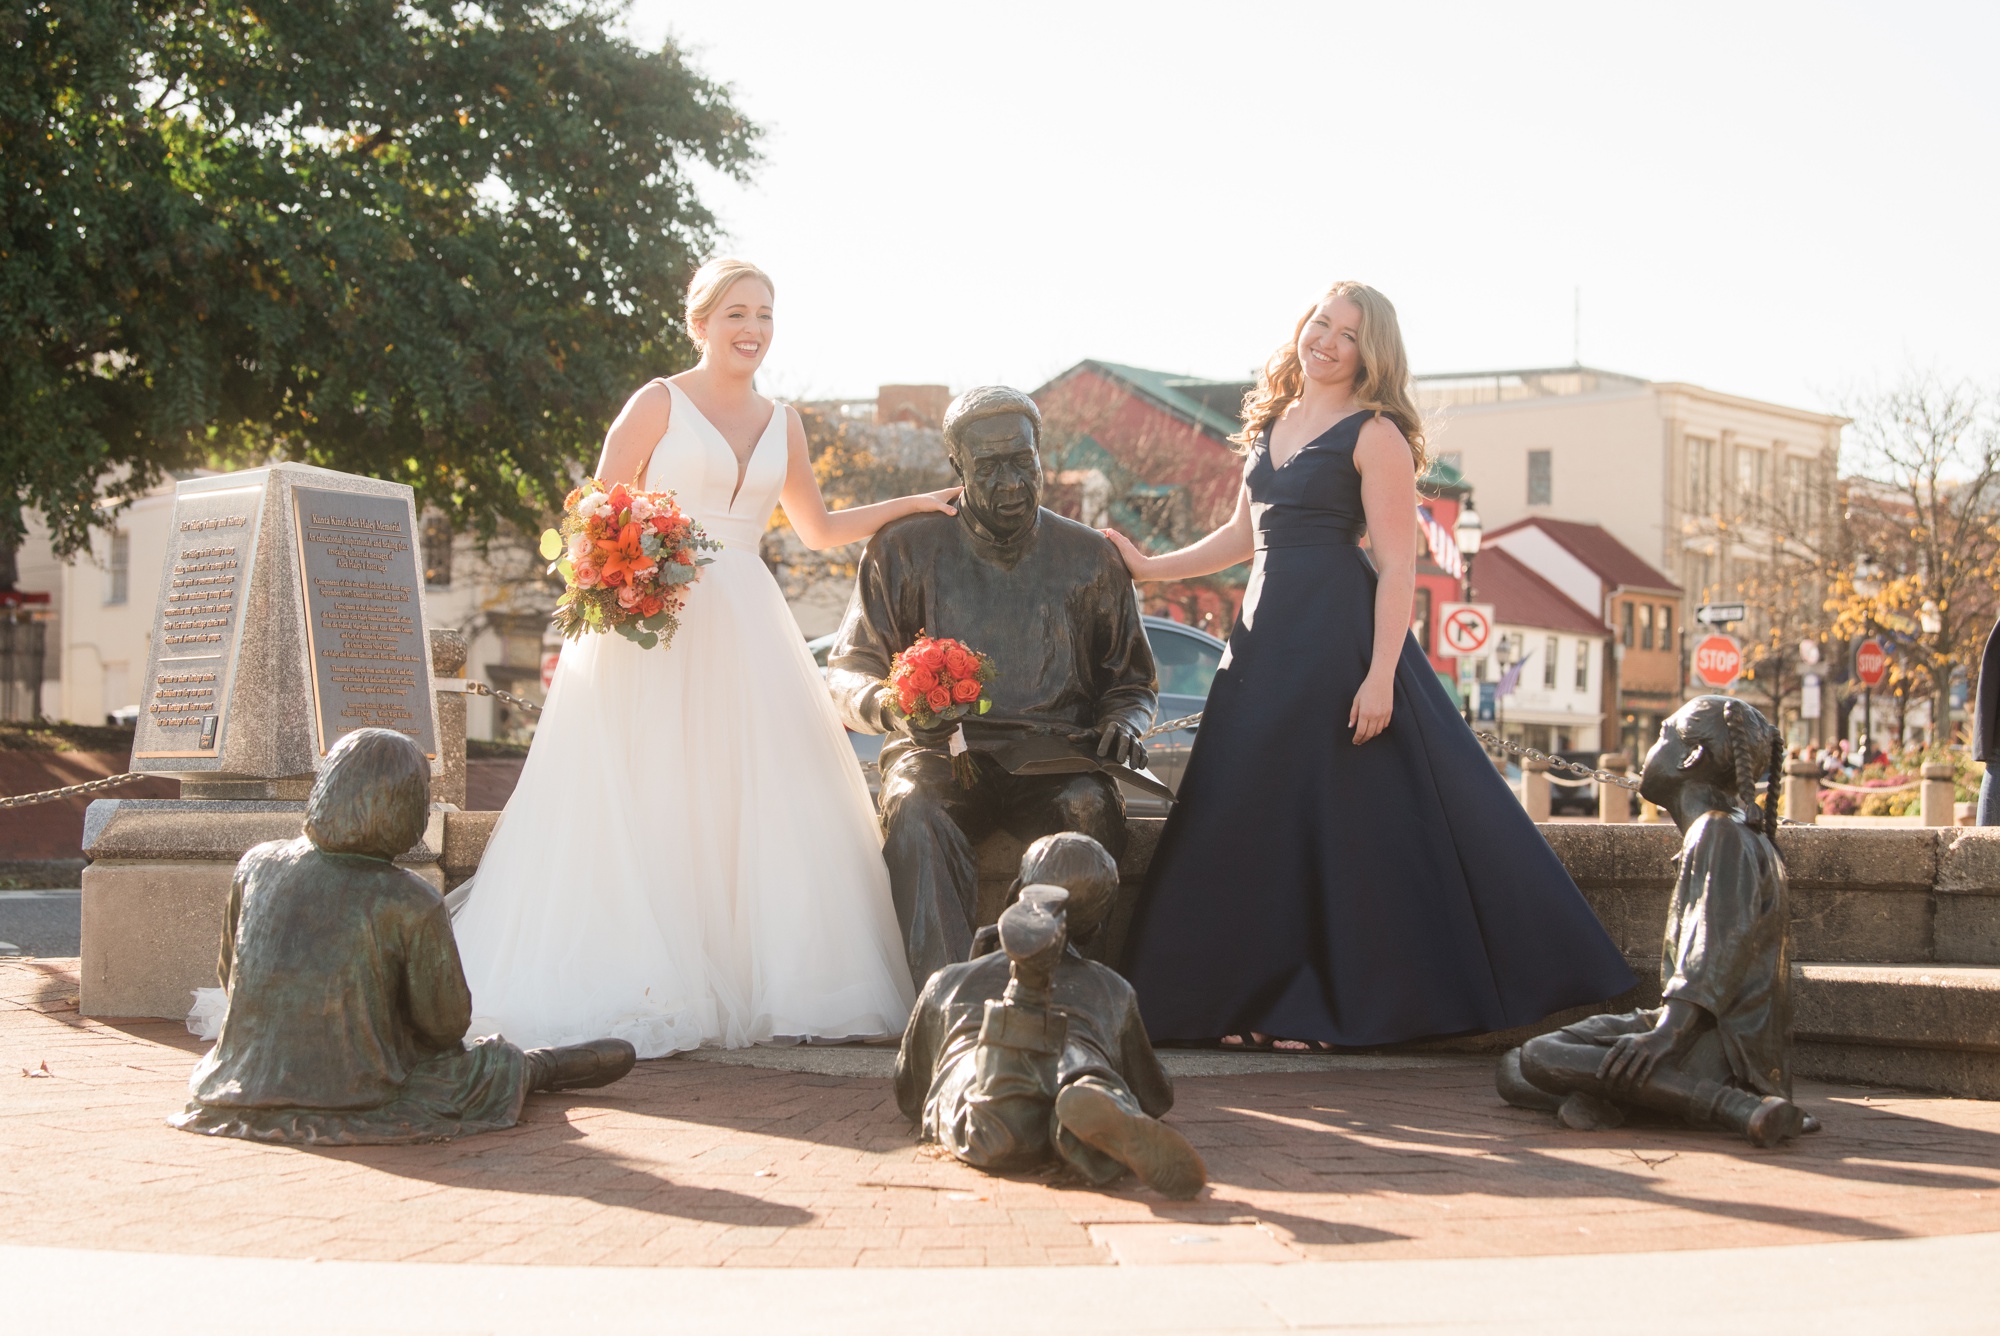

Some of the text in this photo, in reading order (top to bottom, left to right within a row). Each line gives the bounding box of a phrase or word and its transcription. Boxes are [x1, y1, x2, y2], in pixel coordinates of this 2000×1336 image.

[219, 516, 228, 527] and
[312, 514, 329, 524] Kunta
[360, 519, 374, 533] Haley
[376, 520, 401, 532] Memorial
[388, 551, 393, 560] of
[1700, 649, 1738, 672] STOP
[1859, 654, 1882, 672] STOP
